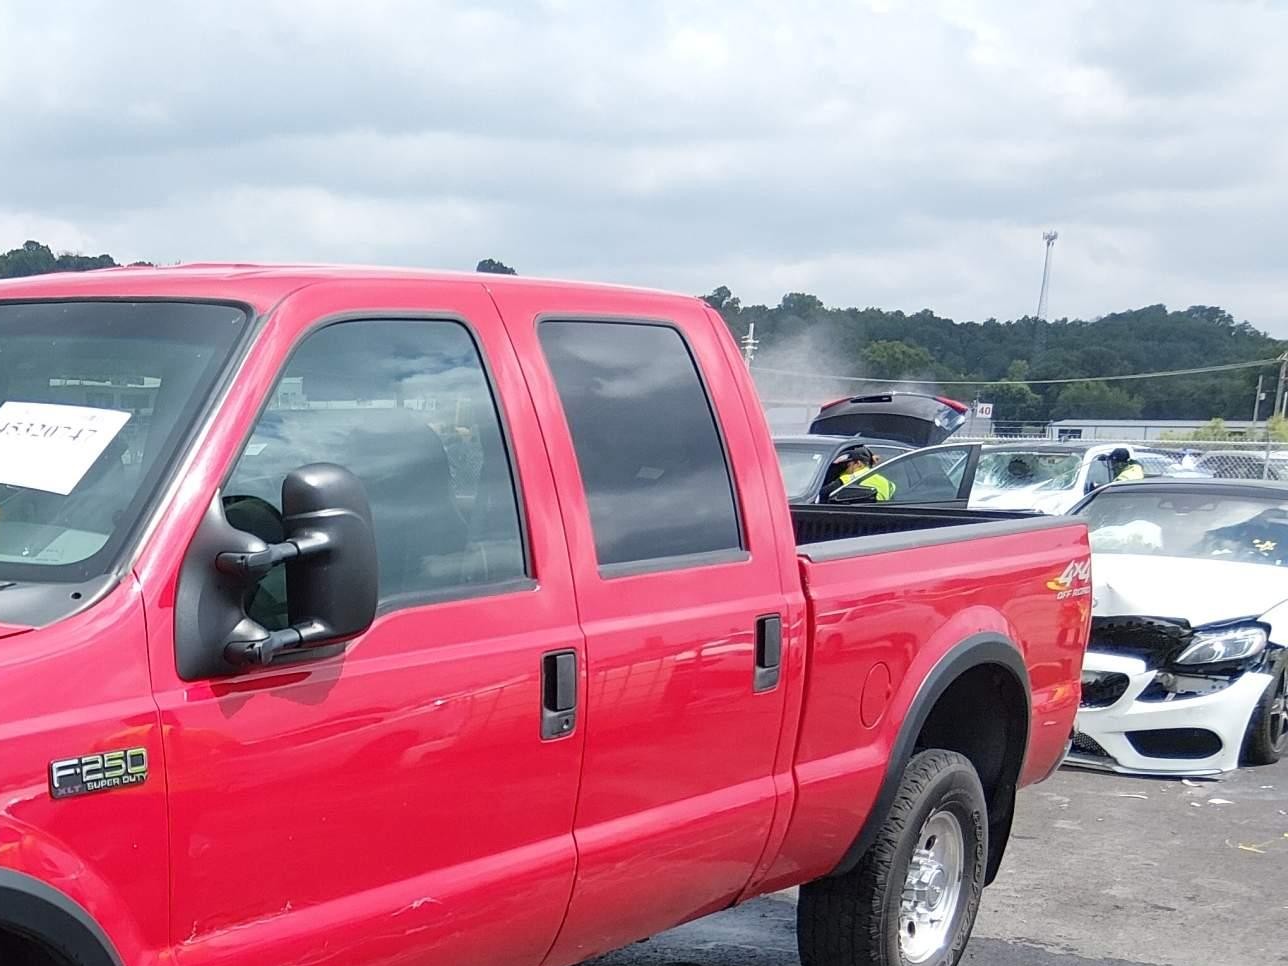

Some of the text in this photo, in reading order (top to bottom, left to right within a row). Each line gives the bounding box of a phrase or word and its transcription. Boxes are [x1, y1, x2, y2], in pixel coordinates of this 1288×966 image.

[978, 406, 991, 416] 40
[52, 748, 148, 788] F-250
[57, 772, 148, 795] XLT SUPER DUTY
